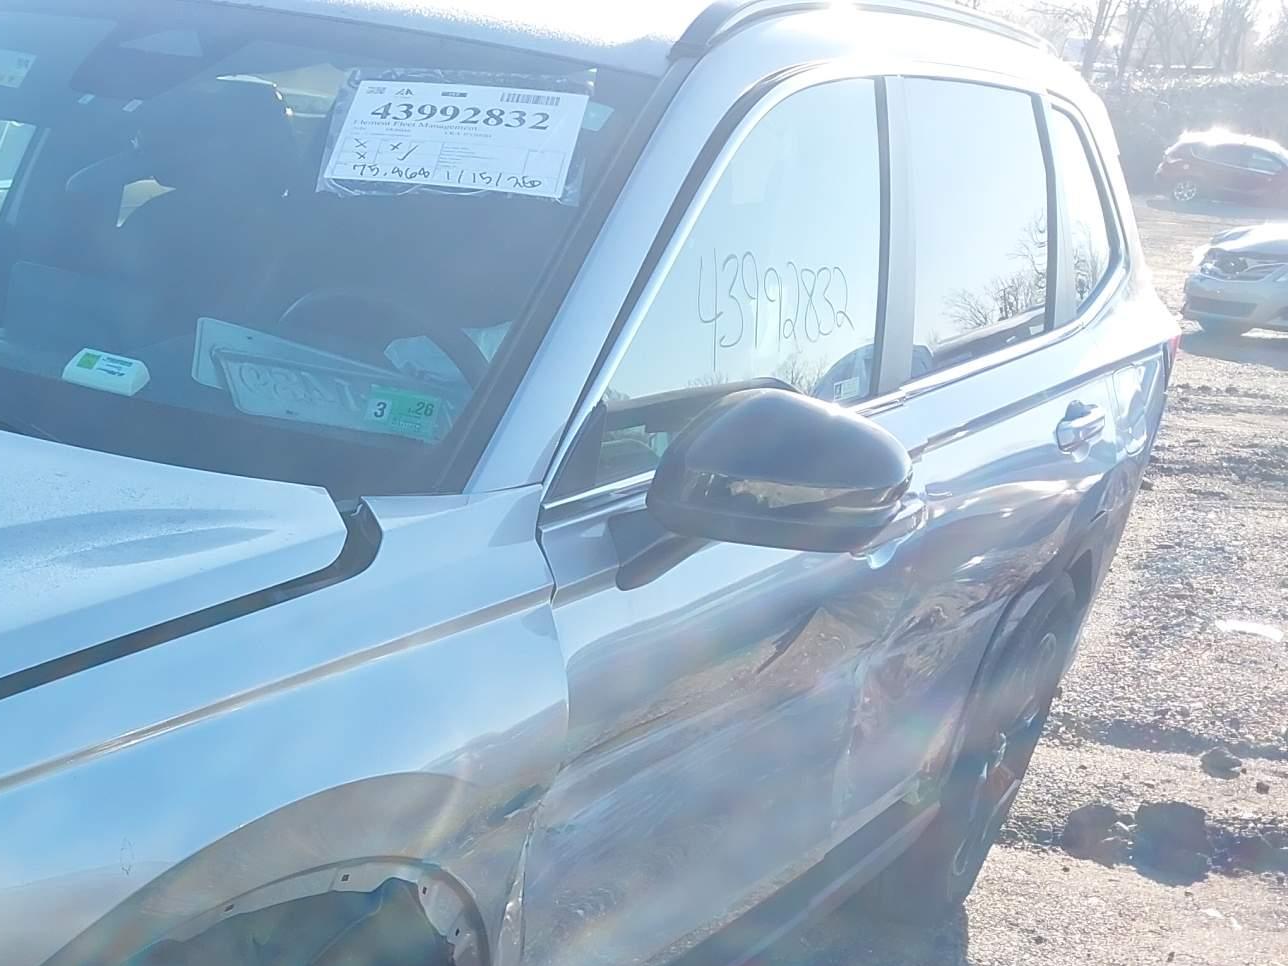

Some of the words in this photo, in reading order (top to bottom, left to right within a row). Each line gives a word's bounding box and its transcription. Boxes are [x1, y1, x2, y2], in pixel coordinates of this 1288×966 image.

[371, 102, 550, 131] 43992832
[698, 248, 855, 372] 43992832
[374, 401, 387, 418] 3
[416, 401, 435, 417] 26
